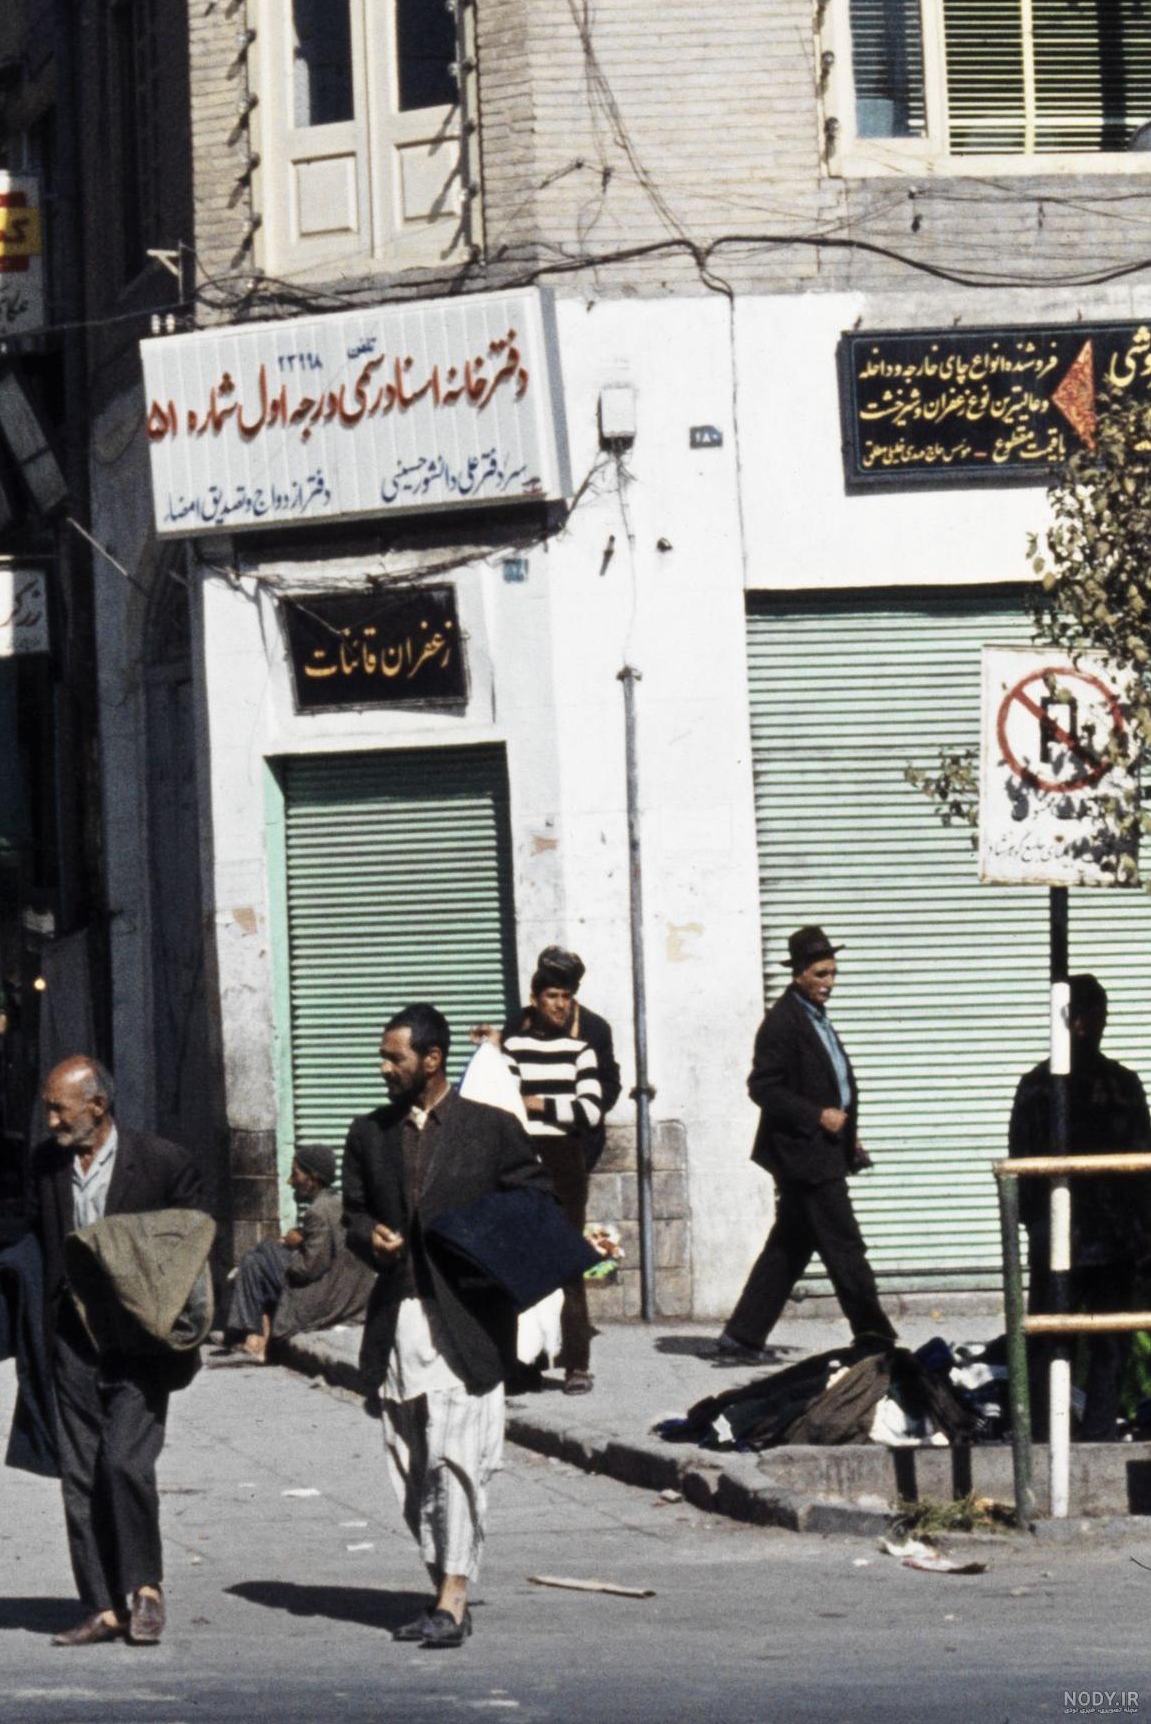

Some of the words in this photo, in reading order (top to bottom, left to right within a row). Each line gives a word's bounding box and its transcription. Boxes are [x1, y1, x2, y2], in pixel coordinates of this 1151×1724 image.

[347, 337, 377, 359] تلفن
[902, 344, 939, 383] خارجه
[969, 343, 1005, 380] انواع
[1006, 341, 1059, 380] فروشنده
[383, 356, 440, 416] اسناد
[939, 354, 969, 384] چای
[188, 372, 238, 437] شماره
[237, 364, 287, 442] اول
[339, 354, 385, 428] رسمی
[923, 387, 969, 424] زعفران
[966, 384, 990, 421] نوع
[146, 399, 178, 440] ۵۱
[289, 392, 338, 443] درجه
[992, 426, 1034, 463] مقطوع
[253, 482, 303, 516] ازدواج
[301, 470, 331, 513] دفتر
[381, 457, 427, 503] حسینی
[201, 485, 247, 524] تصدیق
[381, 621, 451, 678] زعفران
